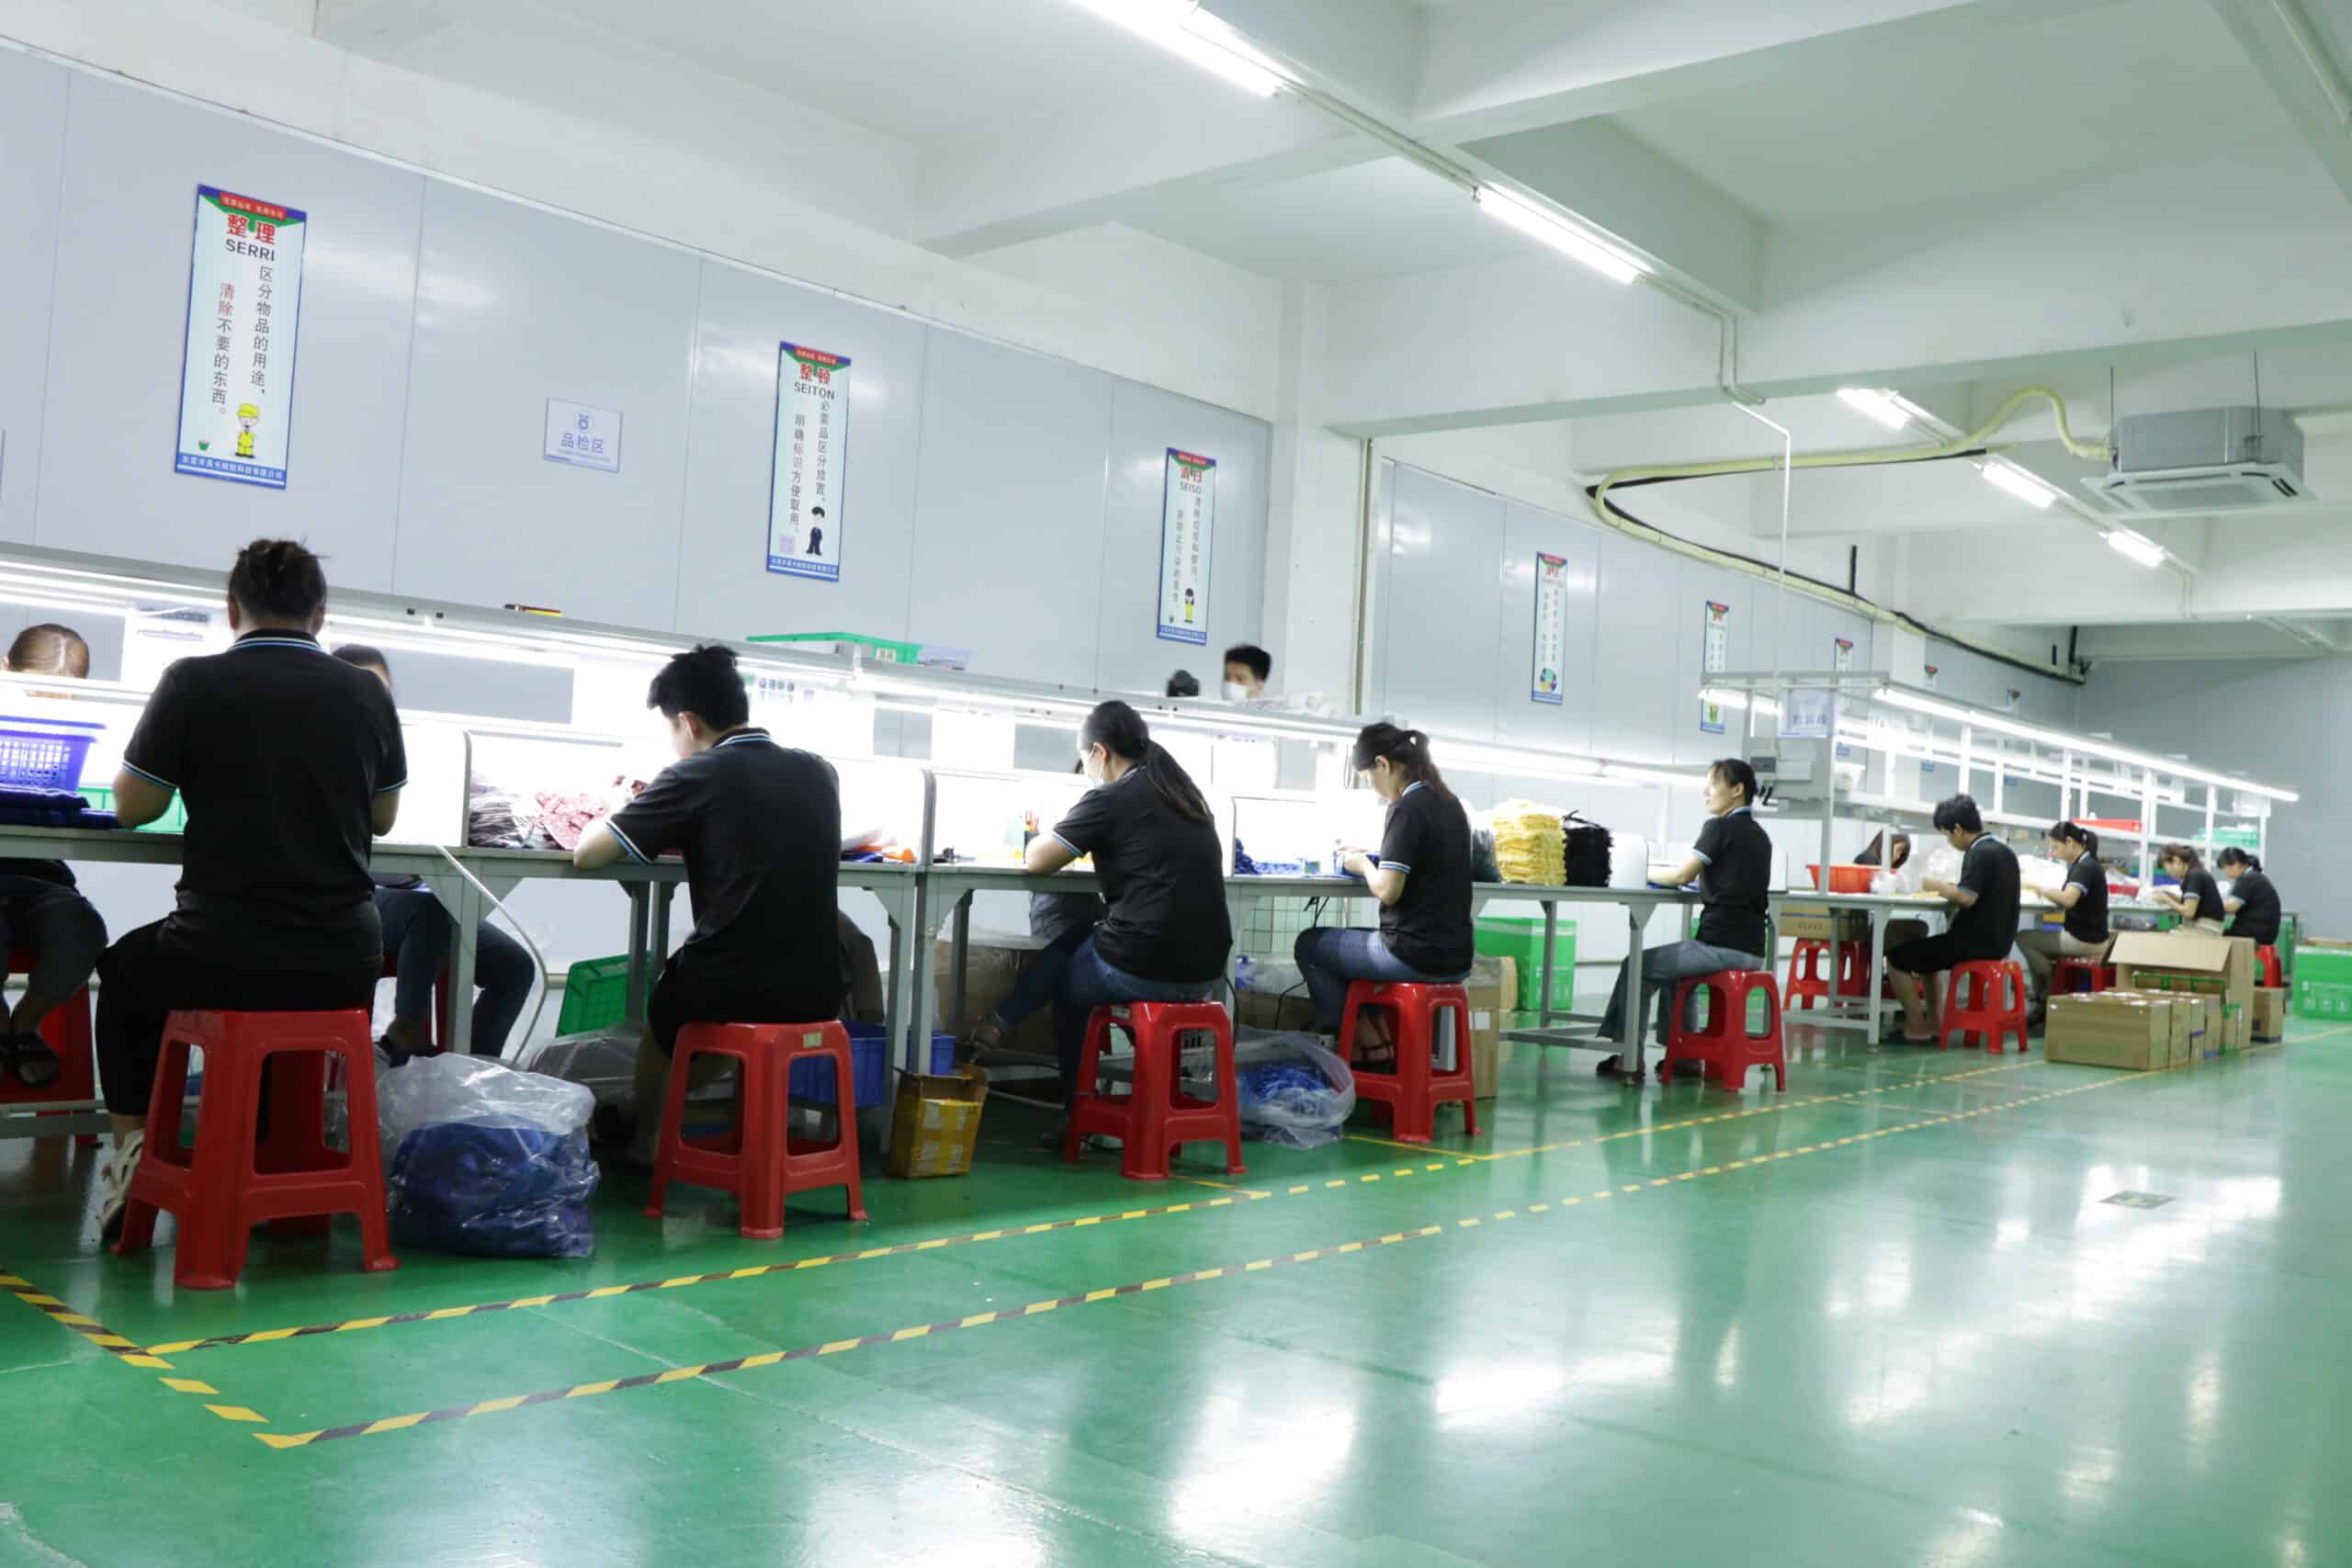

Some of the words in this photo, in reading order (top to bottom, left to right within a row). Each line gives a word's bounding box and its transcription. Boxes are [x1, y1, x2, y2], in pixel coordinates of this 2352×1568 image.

[227, 213, 275, 244] 整理
[226, 239, 275, 262] SERRI
[250, 265, 273, 394] 区分物品的用途，
[211, 283, 235, 413] 清除不要的东西。
[794, 381, 835, 400] SEITON
[560, 433, 604, 455] 品检区
